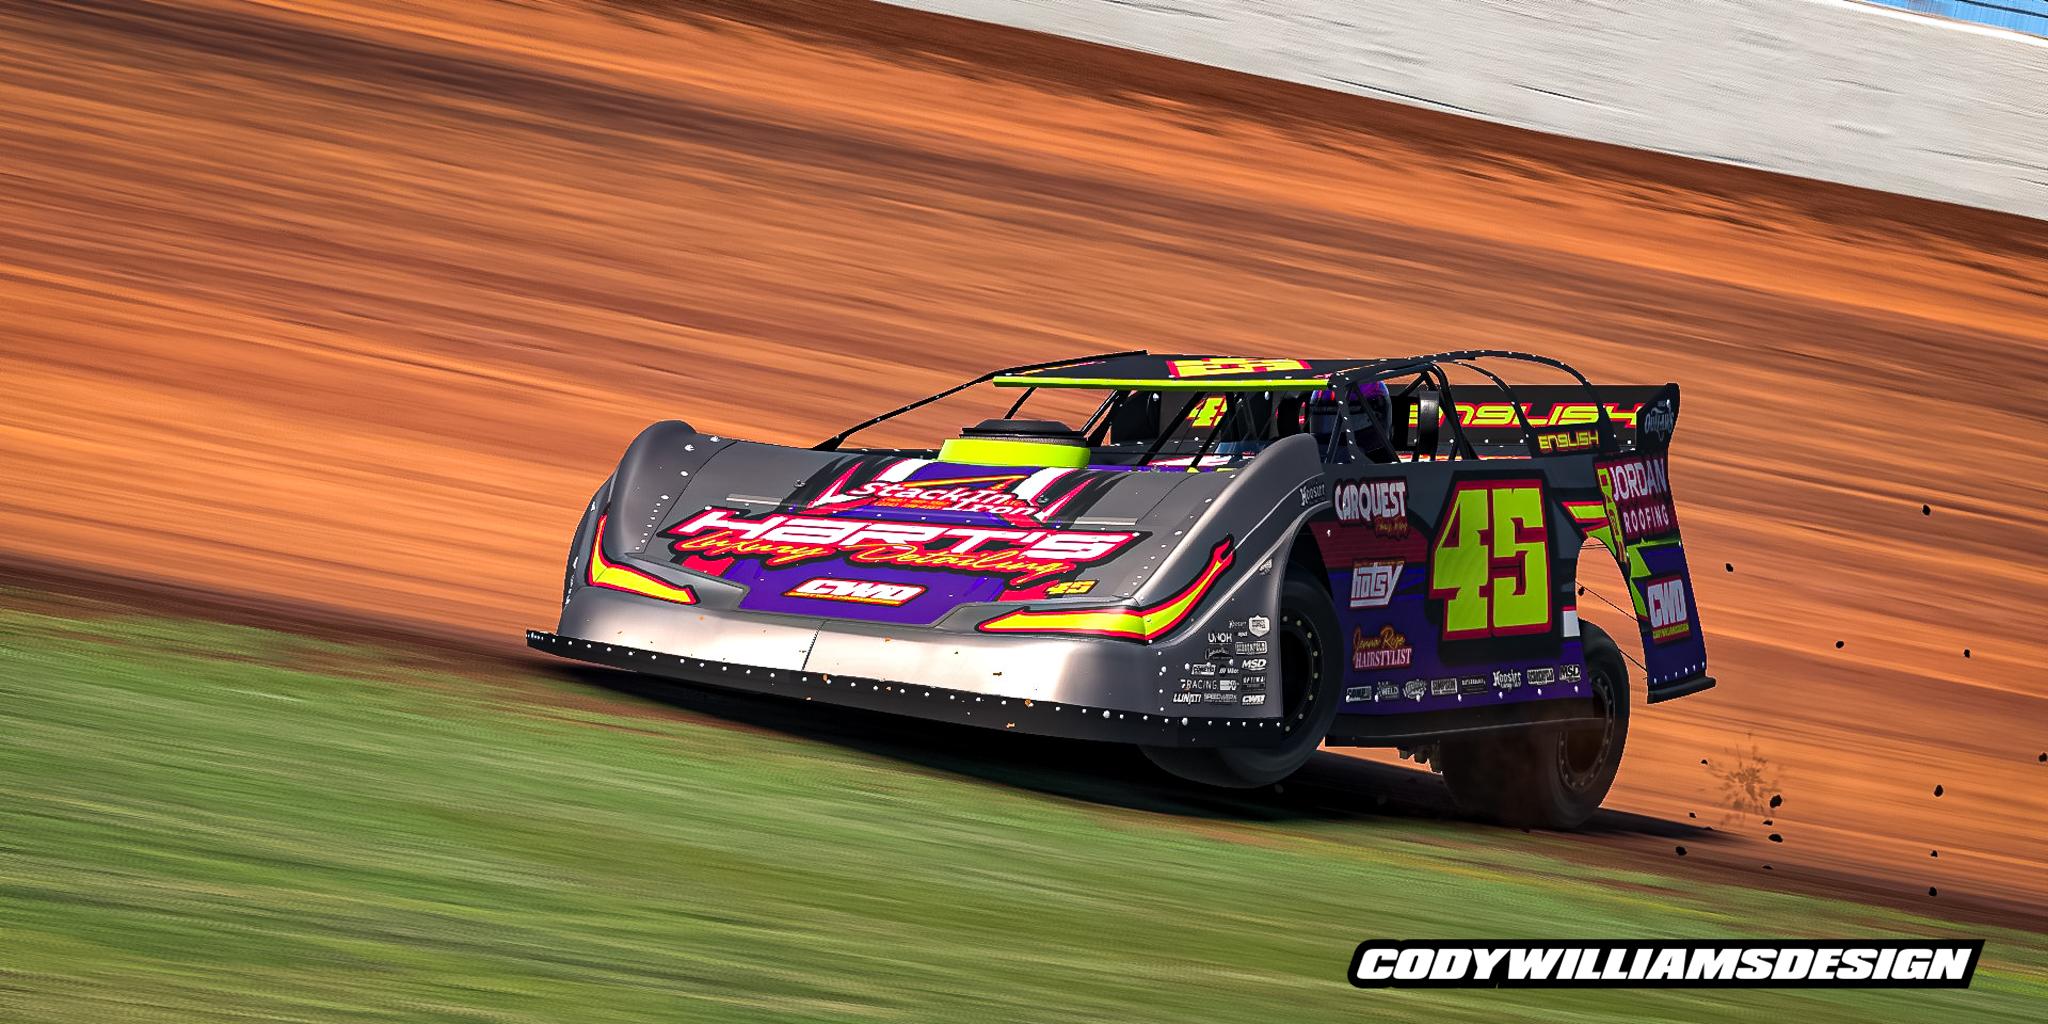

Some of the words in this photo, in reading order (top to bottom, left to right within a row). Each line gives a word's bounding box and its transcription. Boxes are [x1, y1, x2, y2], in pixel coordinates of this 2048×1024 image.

[1610, 458, 1667, 501] JORDAN
[1335, 481, 1406, 521] CARQUEST
[1622, 504, 1669, 533] ROOFING
[1432, 487, 1549, 633] 45
[795, 577, 923, 600] CWD
[1351, 561, 1404, 607] hotsy
[1647, 579, 1688, 628] CWD
[1241, 659, 1267, 670] MSD
[1354, 648, 1412, 669] HAIRSTYLIST
